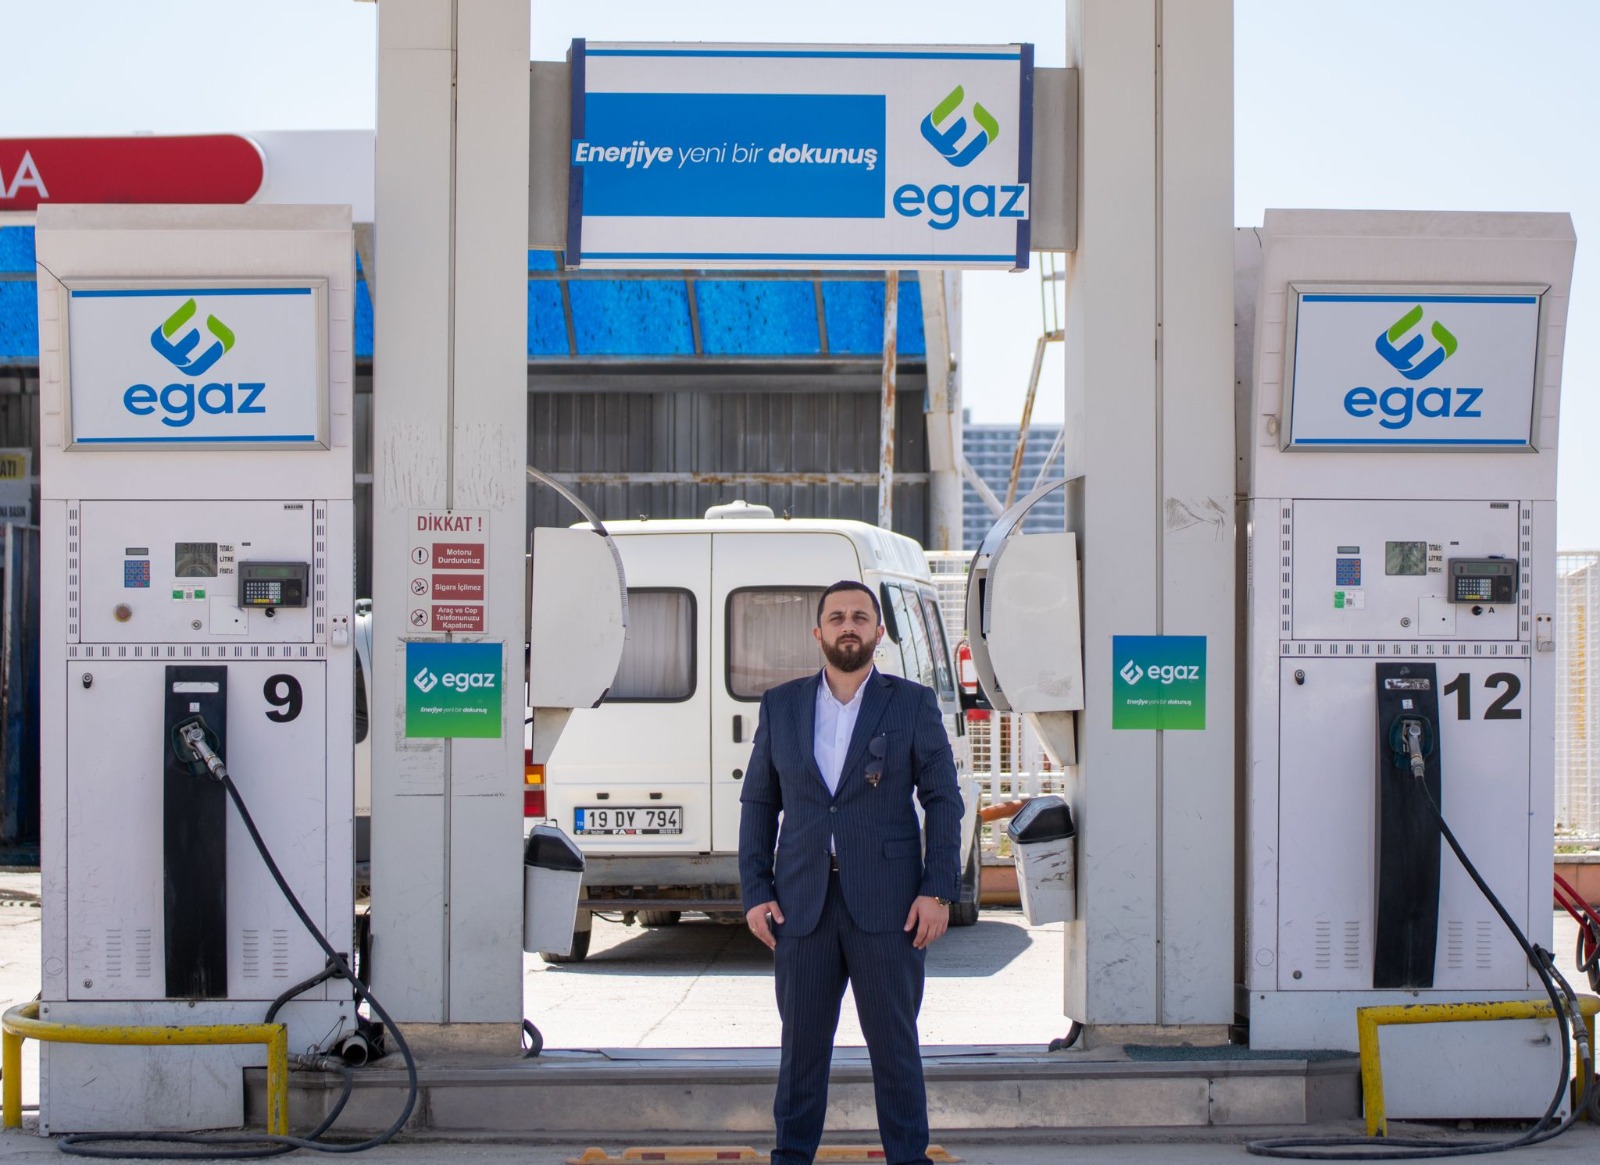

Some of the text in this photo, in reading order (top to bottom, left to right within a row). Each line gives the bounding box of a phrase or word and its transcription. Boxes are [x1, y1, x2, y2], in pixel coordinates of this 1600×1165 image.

[574, 142, 878, 170] Enerjiye yeni bir dokunuş
[0, 149, 49, 198] A
[892, 184, 1025, 230] egaz
[123, 382, 266, 428] egaz
[1344, 386, 1484, 430] egaz
[417, 512, 472, 532] DİKKAT
[458, 581, 481, 591] İçilmez
[443, 622, 473, 630] Kapatınız
[442, 672, 495, 692] egaz
[1147, 665, 1199, 684] egaz
[263, 674, 303, 723] 9
[1444, 672, 1522, 720] 12
[589, 811, 677, 827] 19 DY 794
